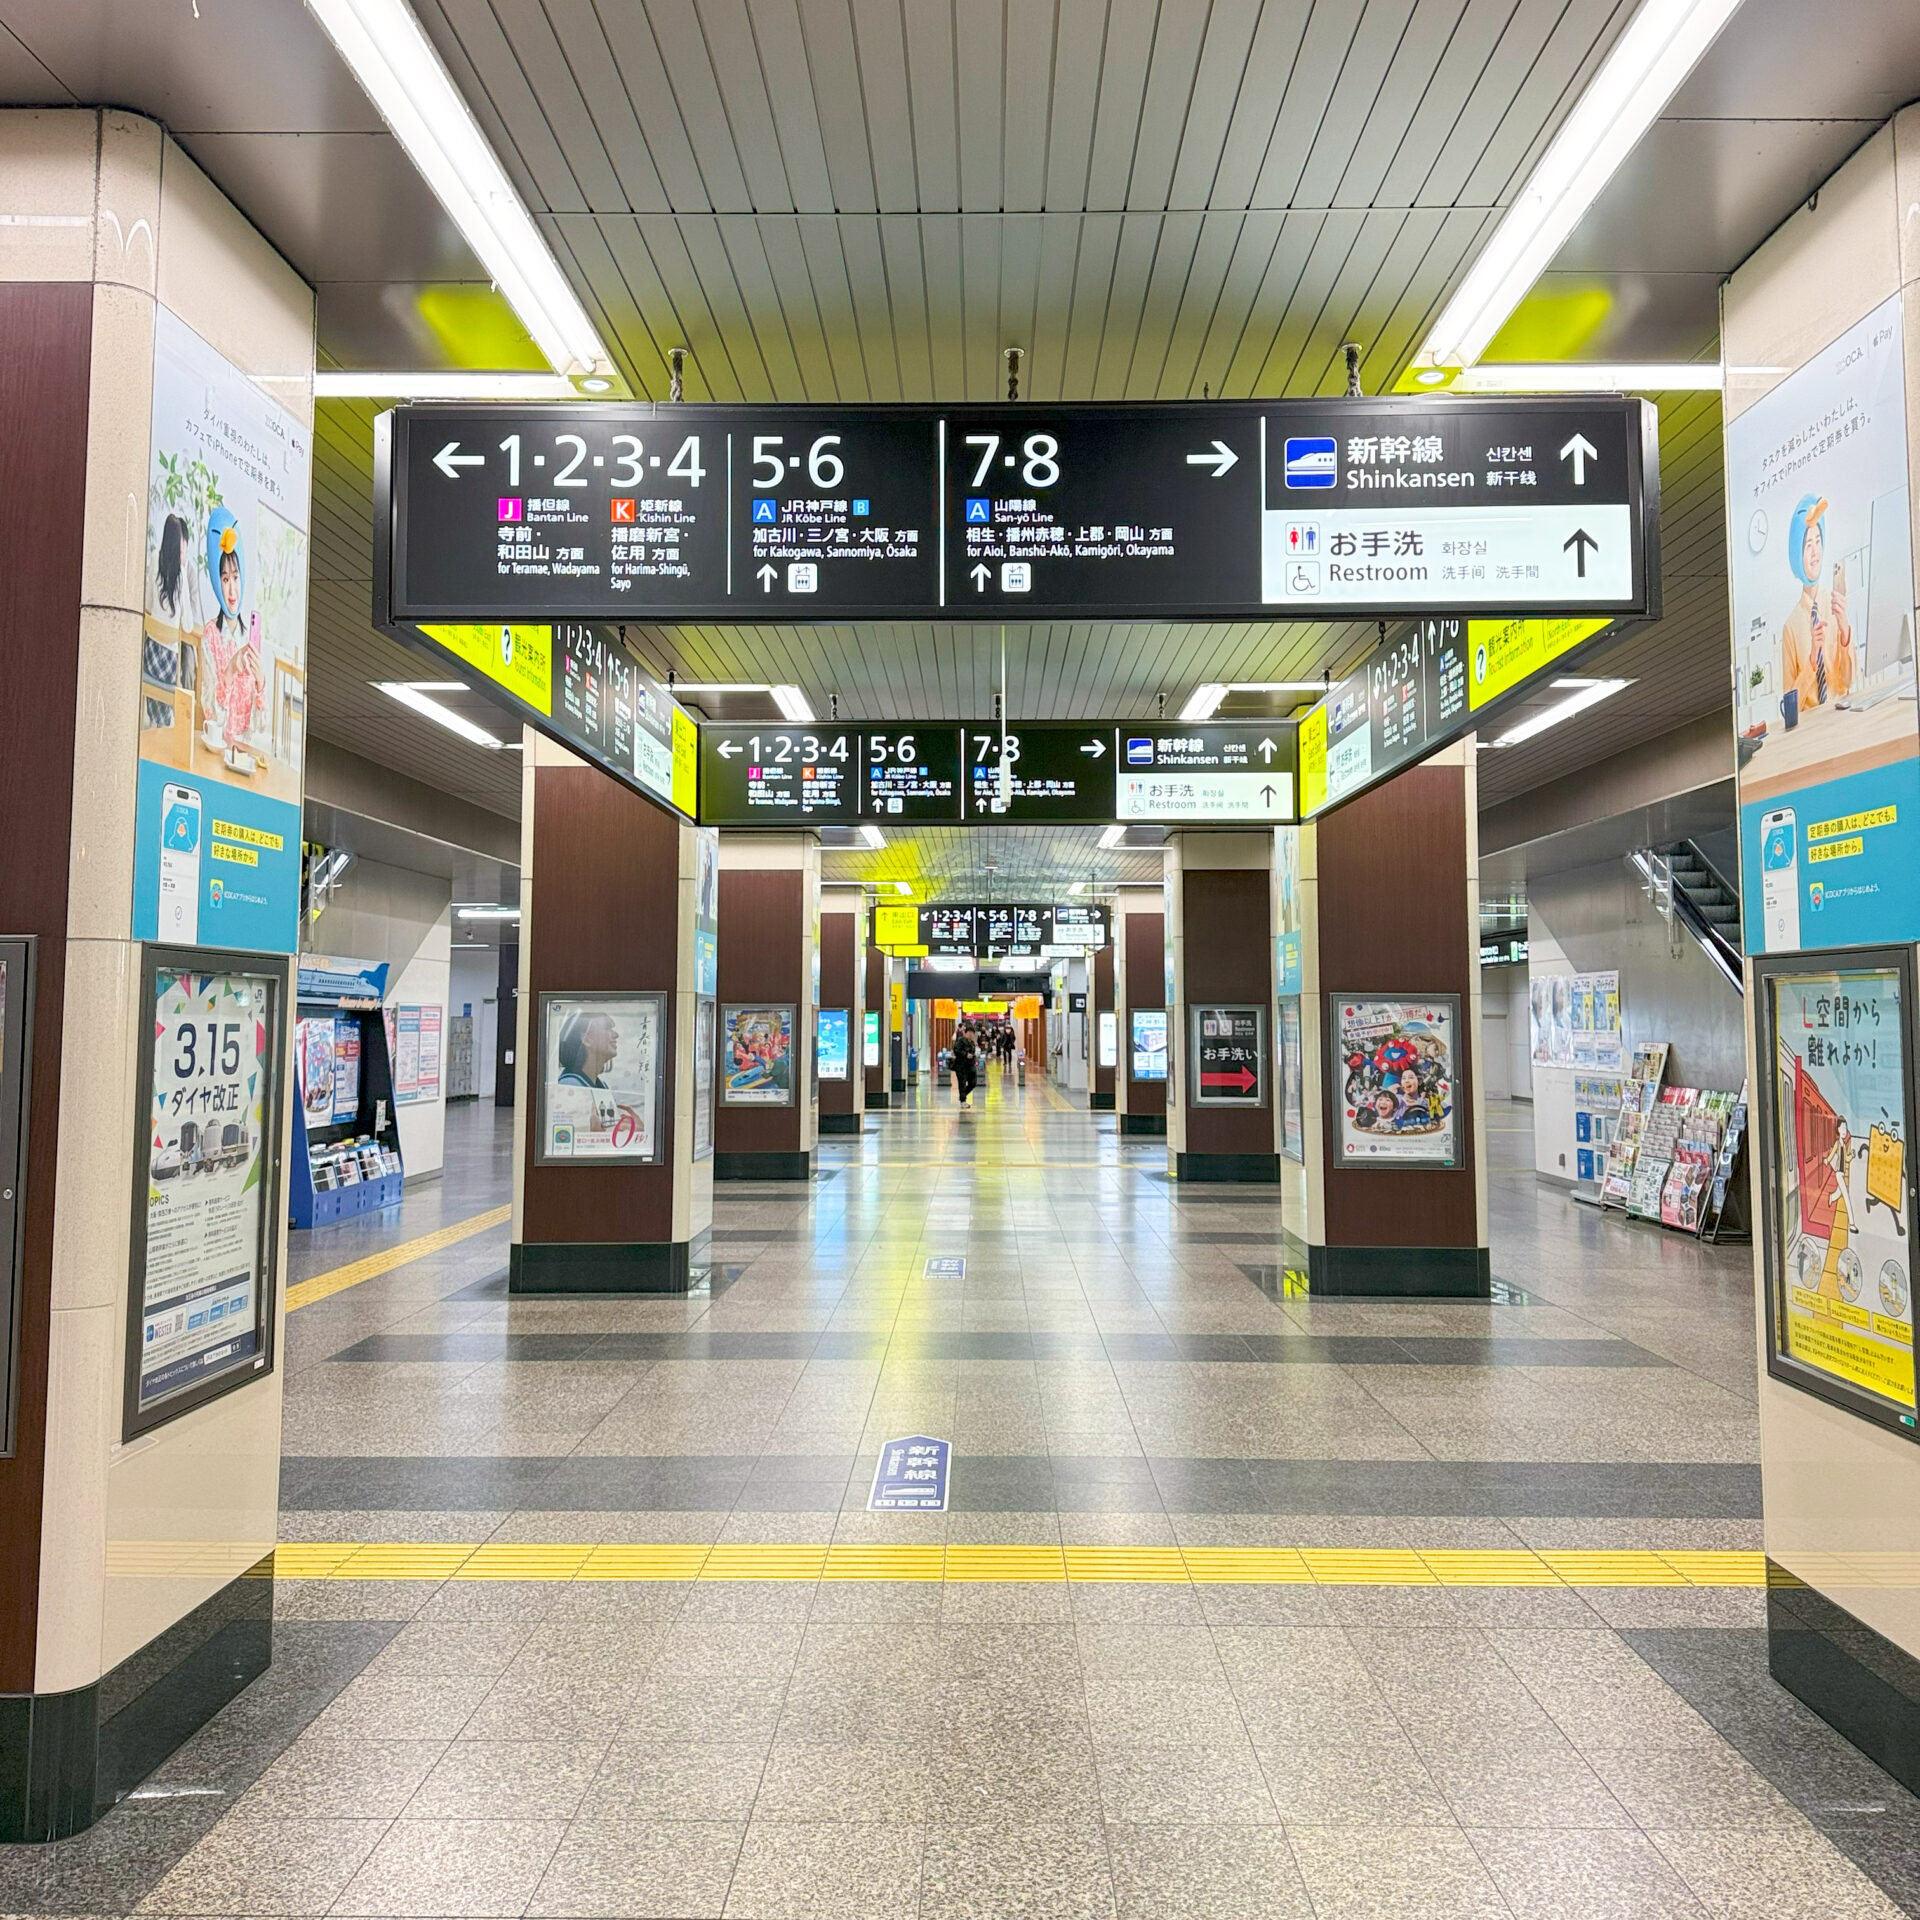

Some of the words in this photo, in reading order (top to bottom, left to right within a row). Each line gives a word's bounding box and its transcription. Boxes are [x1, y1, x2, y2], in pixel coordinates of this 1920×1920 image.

[1347, 436, 1445, 465] 新幹線
[1486, 446, 1532, 464] 신칸센
[1347, 467, 1475, 490] Shinkansen
[1486, 470, 1538, 487] 新干线
[527, 498, 570, 512] 播但線
[640, 499, 683, 512] 姫新線
[756, 503, 773, 520] A
[781, 499, 848, 513] JR神戸線
[970, 502, 986, 519] A
[994, 499, 1037, 512] 山陽線
[527, 513, 564, 523] Bantan
[566, 513, 589, 523] Line
[639, 513, 671, 523] Kishin
[673, 513, 695, 523] Line
[781, 514, 794, 524] JR
[795, 513, 822, 524] Kōbe
[825, 514, 846, 524] Line
[995, 513, 1029, 525] San-yō
[1032, 513, 1054, 523] Line
[895, 529, 919, 543] 方面
[1149, 528, 1173, 541] 方面
[753, 545, 768, 558] for
[769, 545, 824, 560] Kakogawa,
[826, 545, 884, 560] Sannomiya,
[886, 543, 917, 558] Ōsaka
[966, 545, 982, 557] for
[984, 545, 1006, 558] Aioi,
[1126, 544, 1174, 559] Okayama
[1330, 530, 1424, 558] お手洗
[1441, 540, 1489, 558] 화장실
[497, 544, 549, 560] 和田山
[556, 547, 584, 560] 方面
[611, 545, 645, 561] 佐用
[652, 548, 680, 561] 方面
[497, 562, 511, 575] for
[512, 562, 550, 577] Teramae,
[552, 562, 600, 578] Wadayama
[611, 563, 624, 575] for
[1330, 561, 1428, 582] Restroom
[1441, 564, 1486, 580] 洗手间
[1495, 564, 1540, 580] 洗手間
[611, 577, 631, 592] Sayo
[1157, 738, 1204, 753] 新幹線
[1157, 754, 1219, 764] Shinkansen
[1149, 784, 1194, 797] お手洗
[1149, 800, 1197, 809] Restroom
[1810, 841, 1862, 861] 好きな場所から。
[174, 1022, 241, 1079] 3.15
[1203, 1047, 1258, 1061] お手洗い
[1807, 1034, 1877, 1069] 離れよか!
[172, 1083, 240, 1117] ダイヤ改正
